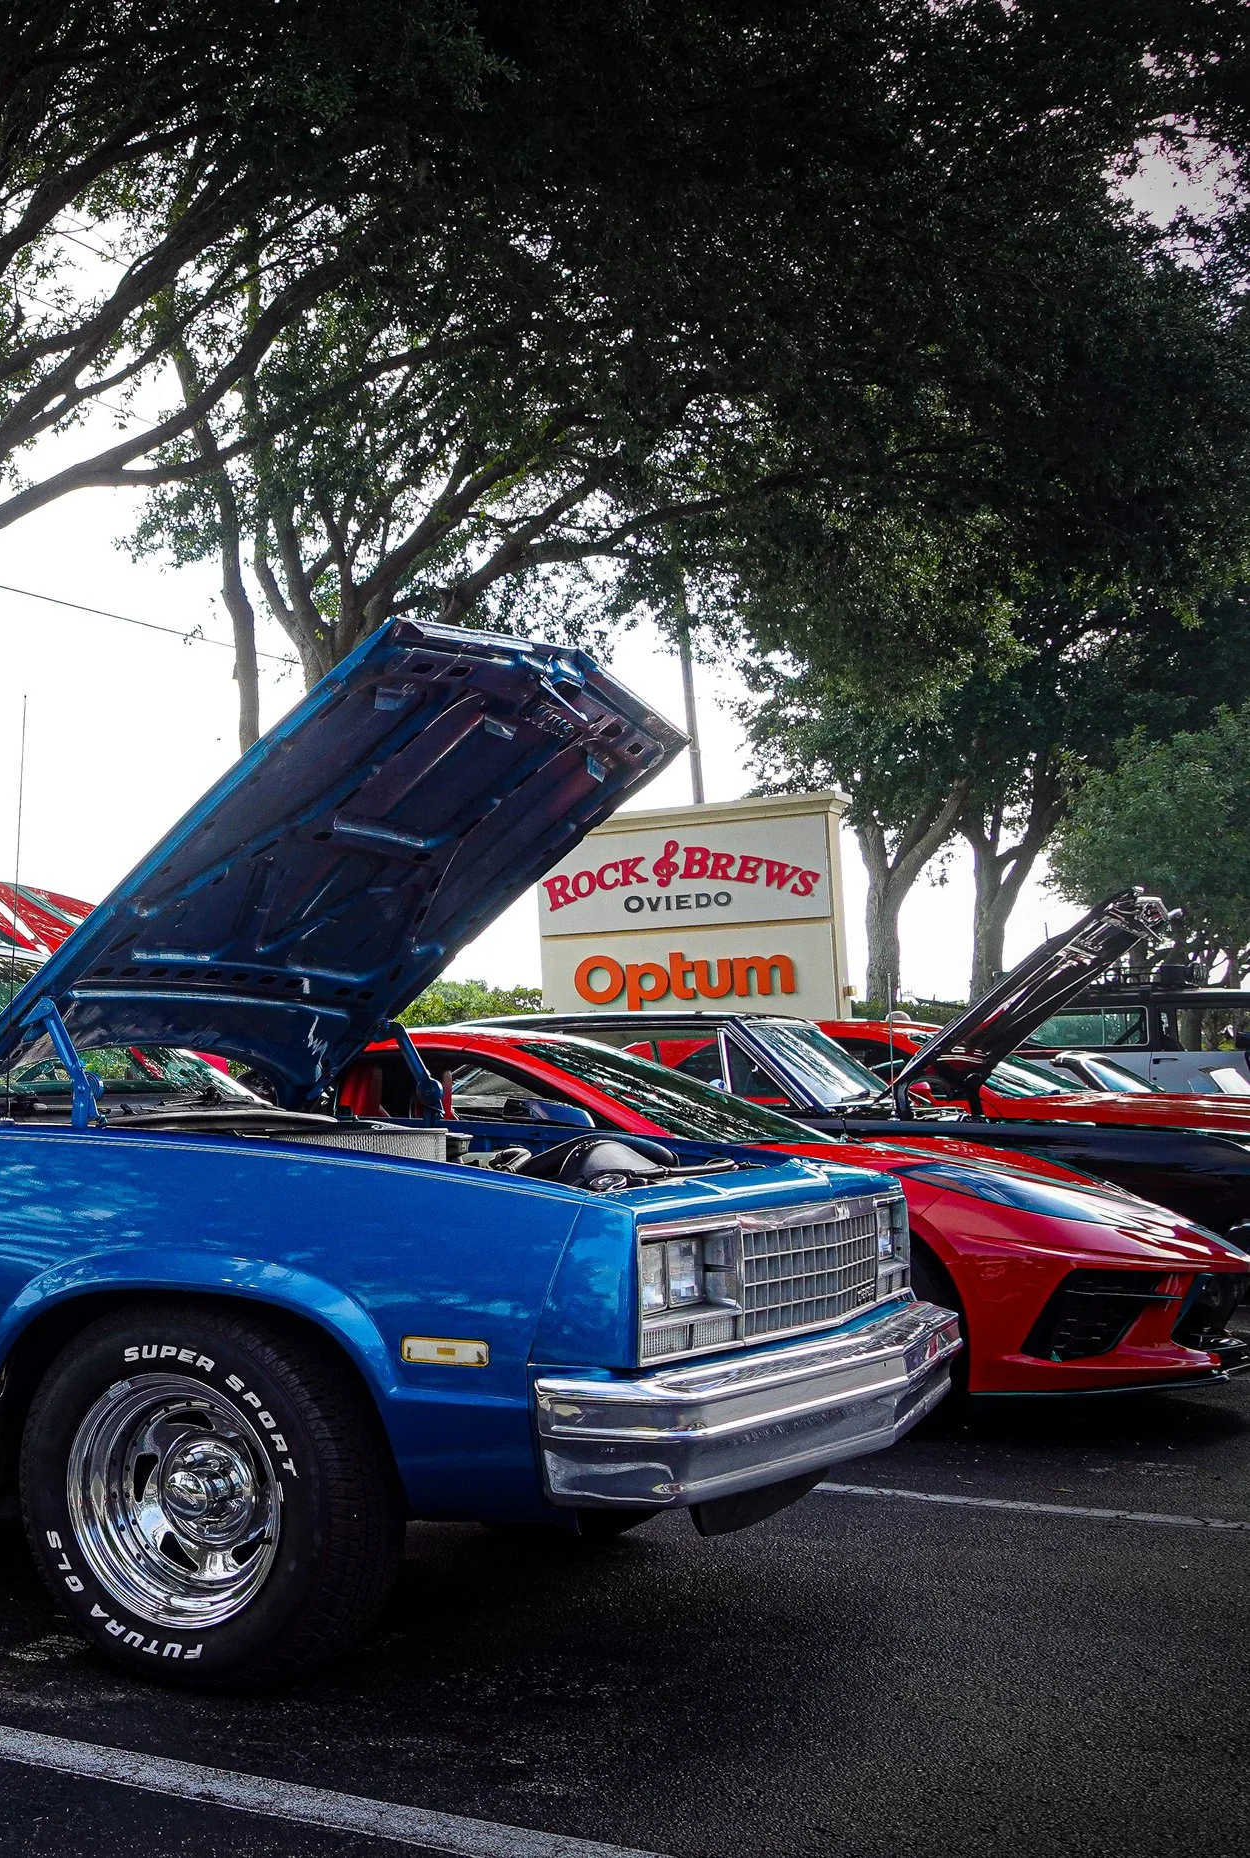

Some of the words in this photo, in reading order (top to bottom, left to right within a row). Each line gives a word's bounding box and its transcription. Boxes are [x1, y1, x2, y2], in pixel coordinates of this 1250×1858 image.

[542, 856, 649, 912] ROCK
[679, 846, 820, 897] BREWS
[624, 891, 732, 913] OVIEDO
[574, 952, 796, 1011] Optum
[123, 1345, 216, 1372] SUPER
[225, 1374, 300, 1479] SPORT
[46, 1530, 85, 1593] GLS
[90, 1603, 204, 1659] FUTURA
